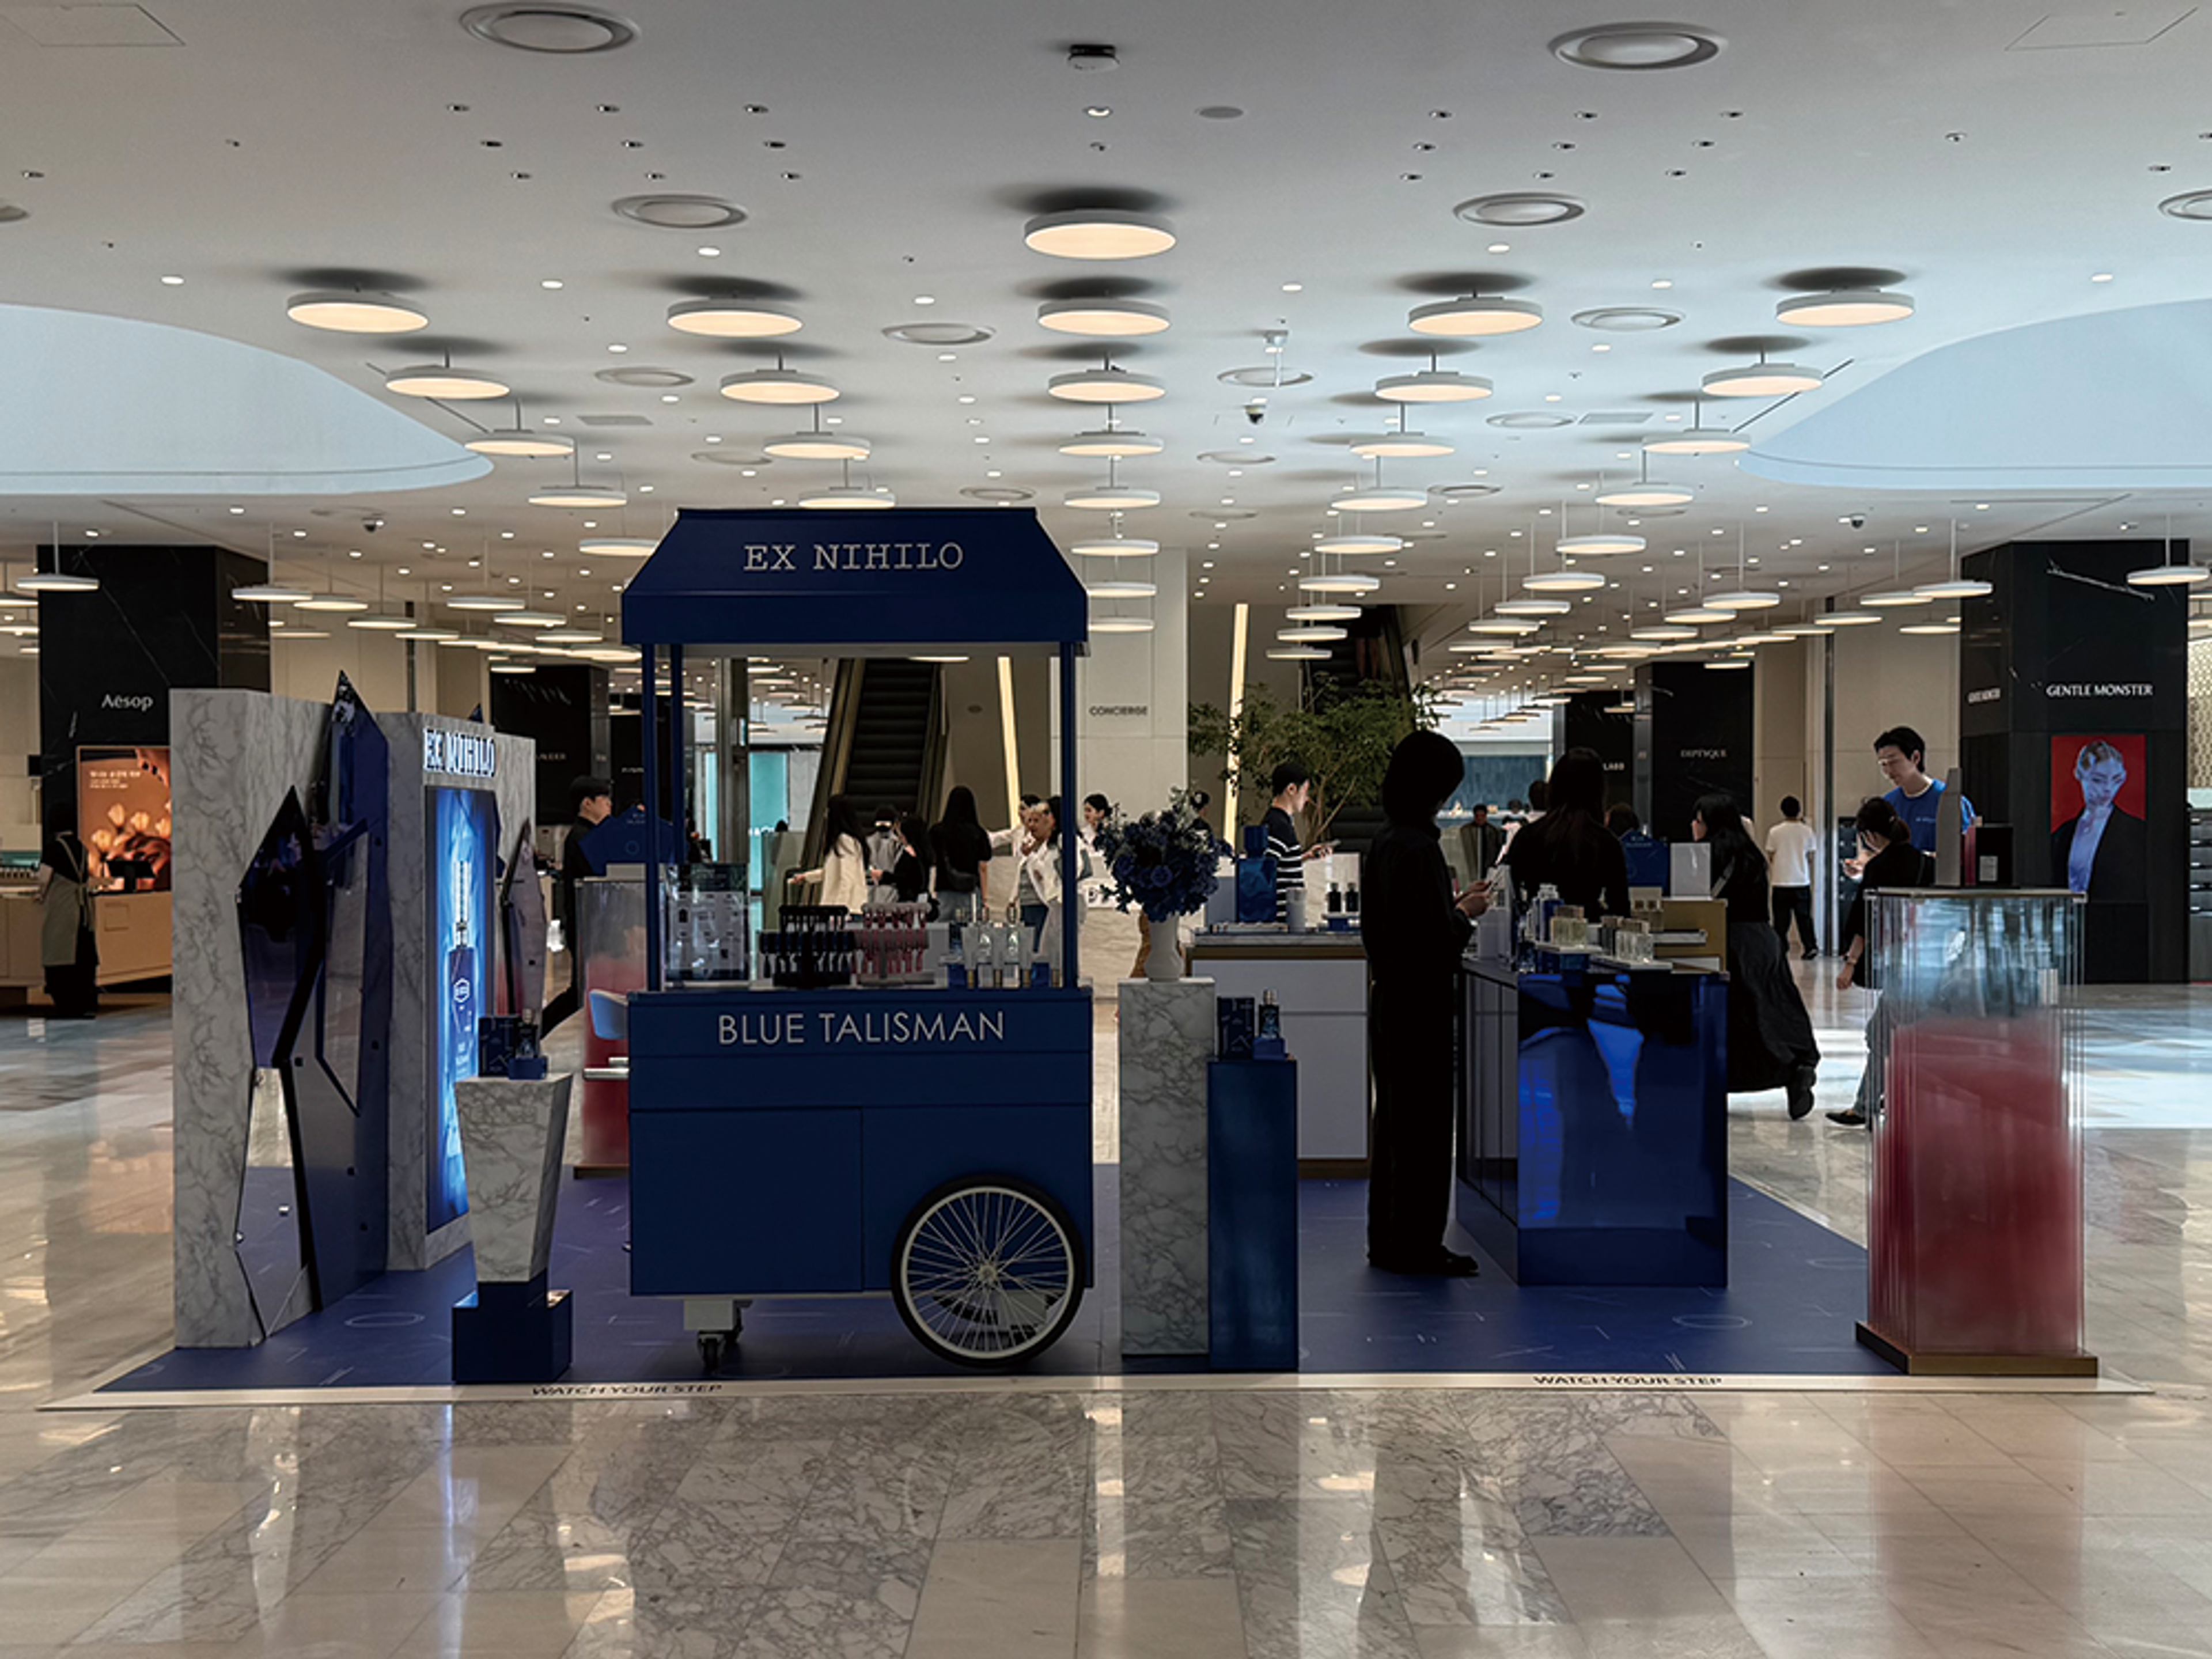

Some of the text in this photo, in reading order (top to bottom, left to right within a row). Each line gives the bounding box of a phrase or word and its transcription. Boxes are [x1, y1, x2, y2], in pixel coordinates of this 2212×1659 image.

[743, 542, 964, 571] EX NIHILO
[2046, 683, 2153, 697] GENTLE MONSTER
[1088, 705, 1147, 717] CONCIERGE
[423, 726, 495, 778] EX NIHILO
[718, 1011, 1003, 1044] BLUE TALISMAN
[1533, 1376, 1722, 1385] WATCH YOUR STEP
[532, 1384, 722, 1396] WATCH YOUR STEP
